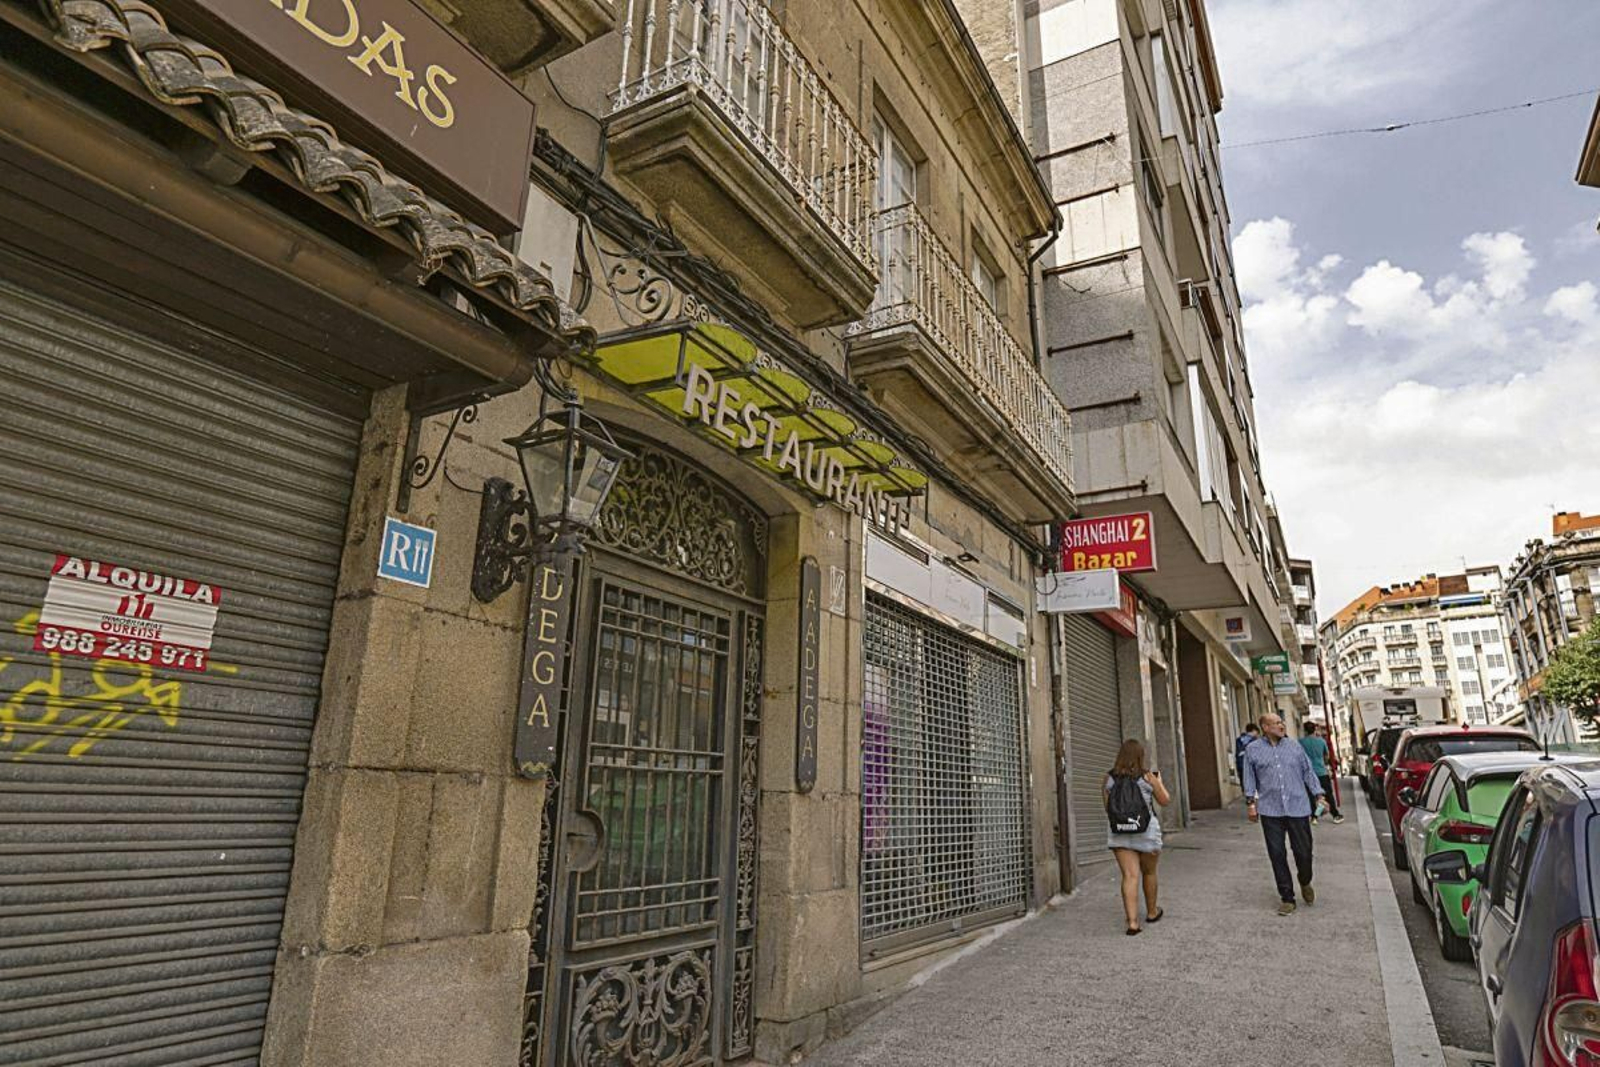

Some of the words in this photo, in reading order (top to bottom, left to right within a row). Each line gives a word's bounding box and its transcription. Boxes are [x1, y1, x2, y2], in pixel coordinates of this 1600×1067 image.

[271, 0, 457, 128] DAS
[682, 362, 910, 538] RESTAURANTE
[386, 530, 411, 571] R
[1064, 520, 1129, 548] SHANGHAI
[1131, 518, 1147, 541] 2
[57, 556, 214, 604] ALQUILA
[1073, 548, 1138, 571] Bazar
[41, 627, 96, 654] 988
[102, 637, 153, 661] 245
[160, 645, 204, 668] 971
[526, 532, 564, 728] DEGA
